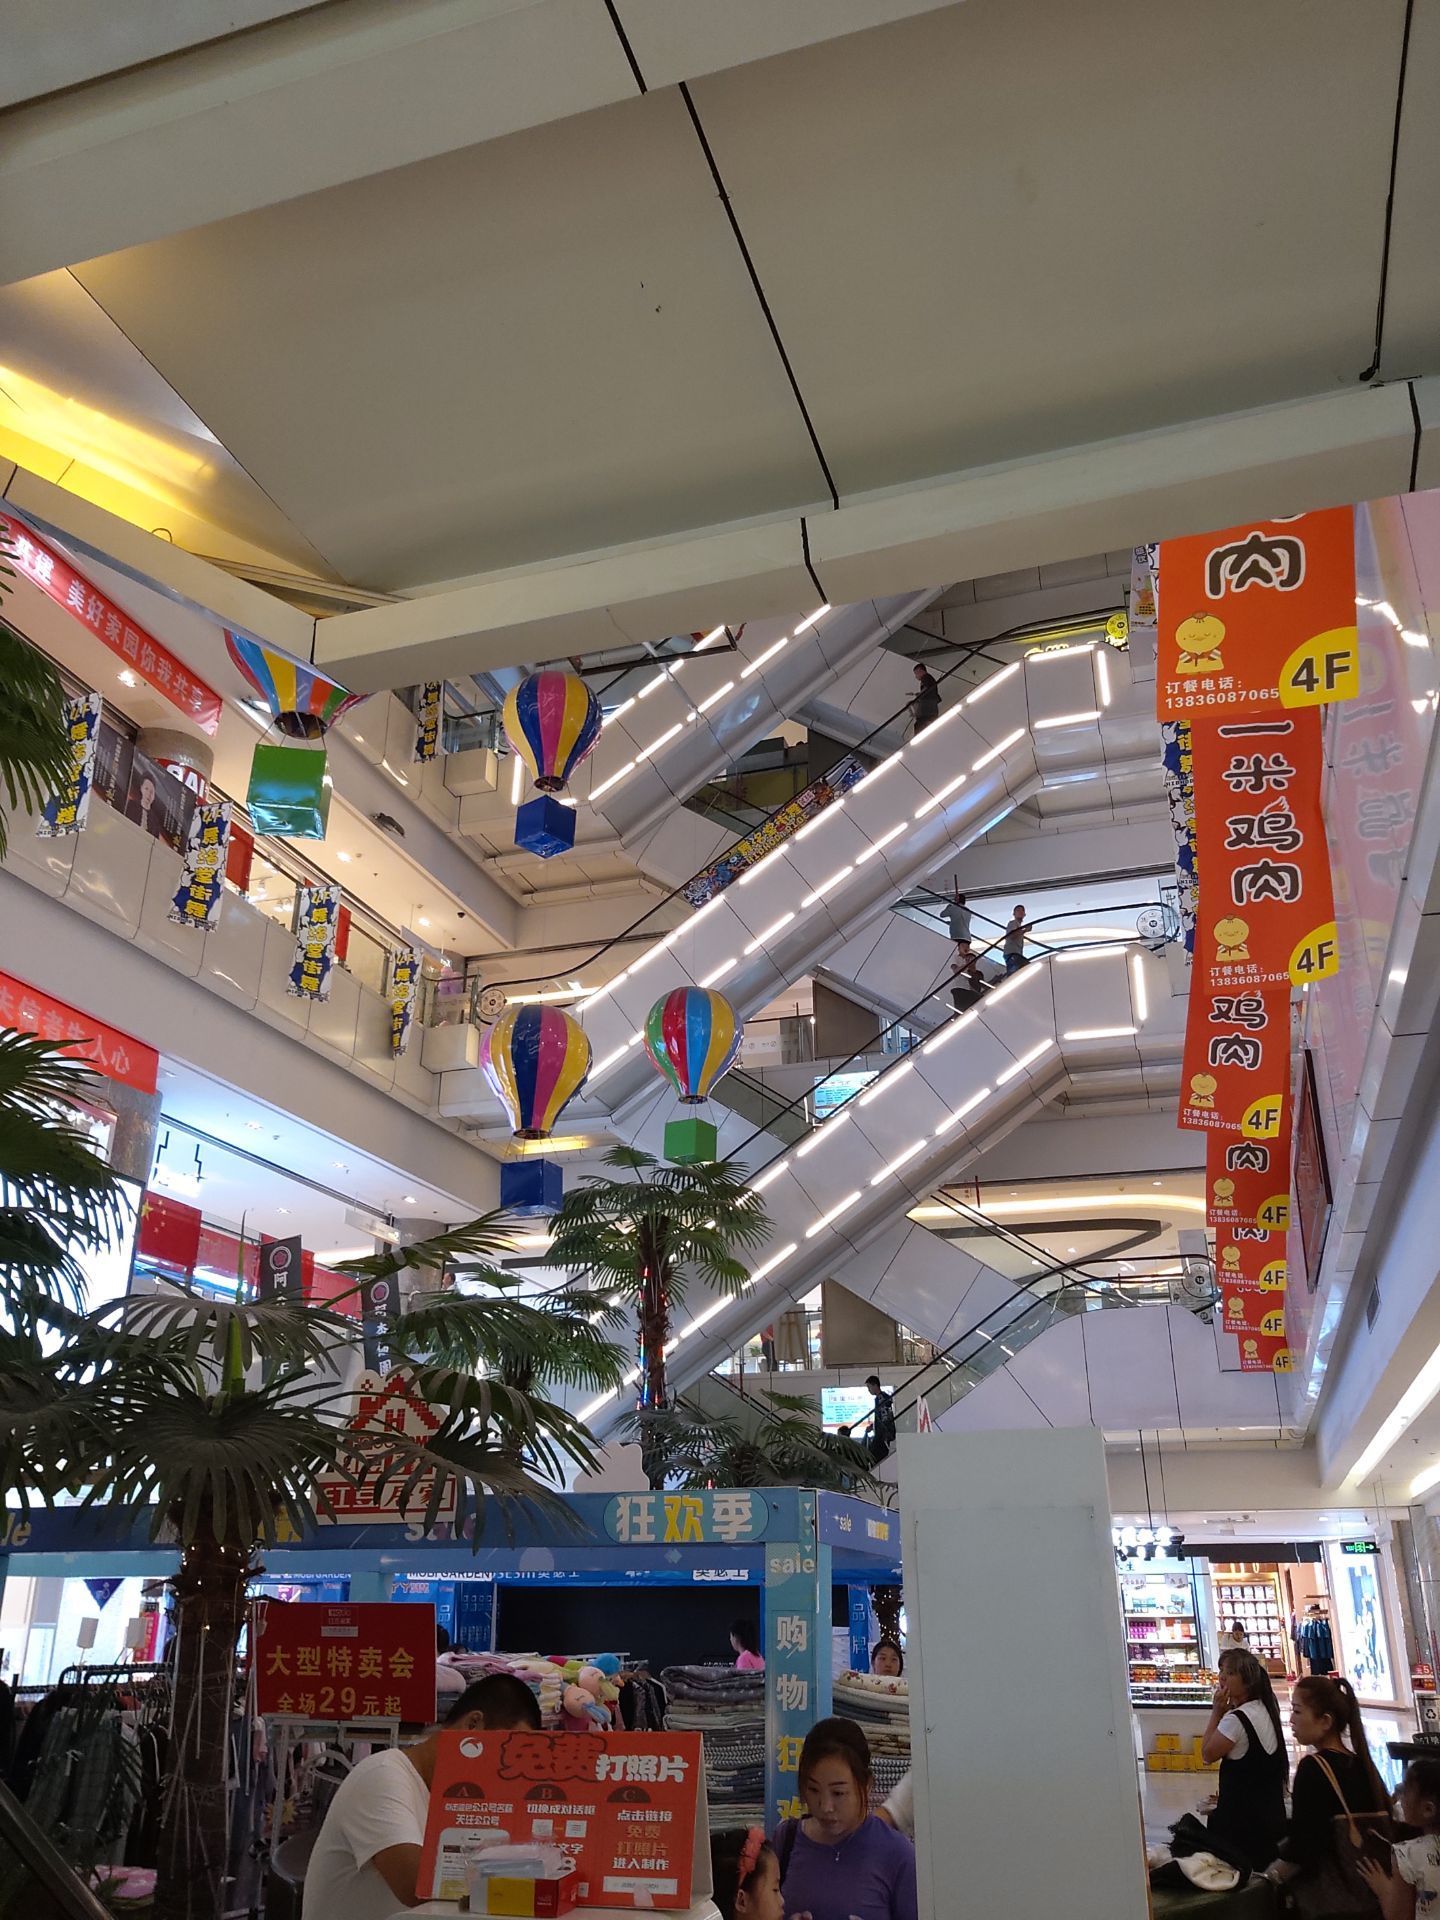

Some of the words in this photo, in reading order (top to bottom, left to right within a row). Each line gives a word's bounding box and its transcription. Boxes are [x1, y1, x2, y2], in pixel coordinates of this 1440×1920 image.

[1205, 531, 1306, 600] 肉
[67, 579, 204, 711] 美好家园你我共享
[1291, 651, 1351, 693] 4F
[1166, 688, 1279, 708] 13836087065
[202, 808, 224, 824] 4F
[1217, 719, 1303, 906] 一米鸡肉
[311, 891, 331, 905] 4F
[1296, 940, 1334, 974] 4F
[1210, 971, 1290, 987] 13836087065
[1208, 990, 1268, 1070] 鸡肉
[1247, 1109, 1278, 1130] 4F
[1226, 1141, 1270, 1174] 肉
[1261, 1206, 1288, 1225] 4F
[1263, 1270, 1285, 1285] 4F
[1264, 1319, 1282, 1331] 4F
[1275, 1356, 1289, 1368] 4F
[615, 1493, 753, 1543] 狂欢季
[839, 1512, 852, 1532] sale
[770, 1553, 815, 1574] sale
[266, 1645, 415, 1679] 大型特卖会
[277, 1686, 402, 1716] 全场29元起
[527, 1803, 597, 1816] 切换成对话框
[617, 1810, 673, 1823] 点击链接
[626, 1825, 661, 1840] 免费
[617, 1841, 668, 1857] 打照片
[612, 1857, 670, 1871] 进入制作
